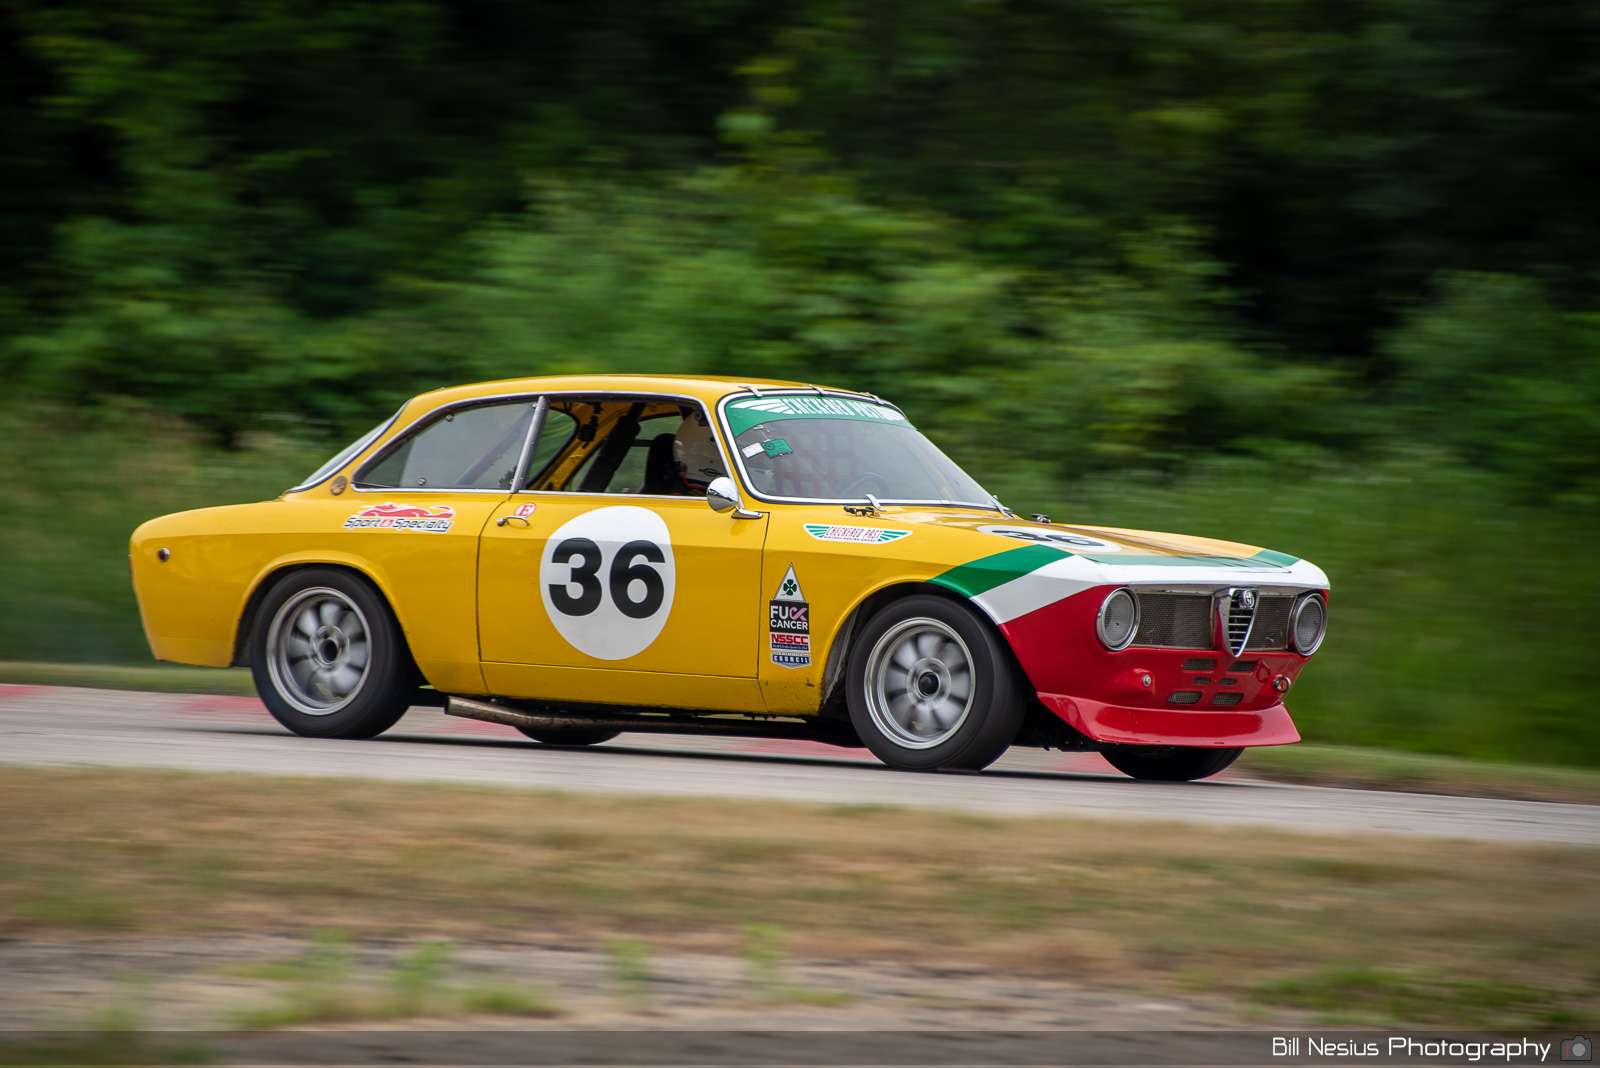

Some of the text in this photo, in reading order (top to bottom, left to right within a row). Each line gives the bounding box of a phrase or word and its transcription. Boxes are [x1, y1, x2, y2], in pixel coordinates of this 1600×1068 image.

[781, 398, 856, 416] CHECKERED
[518, 504, 533, 517] E
[343, 517, 380, 530] Sport
[392, 518, 453, 530] Specialty
[825, 526, 884, 540] CHECKERED PAST
[992, 530, 1105, 546] 36
[548, 537, 666, 620] 36
[770, 605, 808, 621] FUCK
[770, 619, 808, 630] CANCER
[771, 634, 809, 645] NSSCC
[773, 655, 809, 663] COUNCIL
